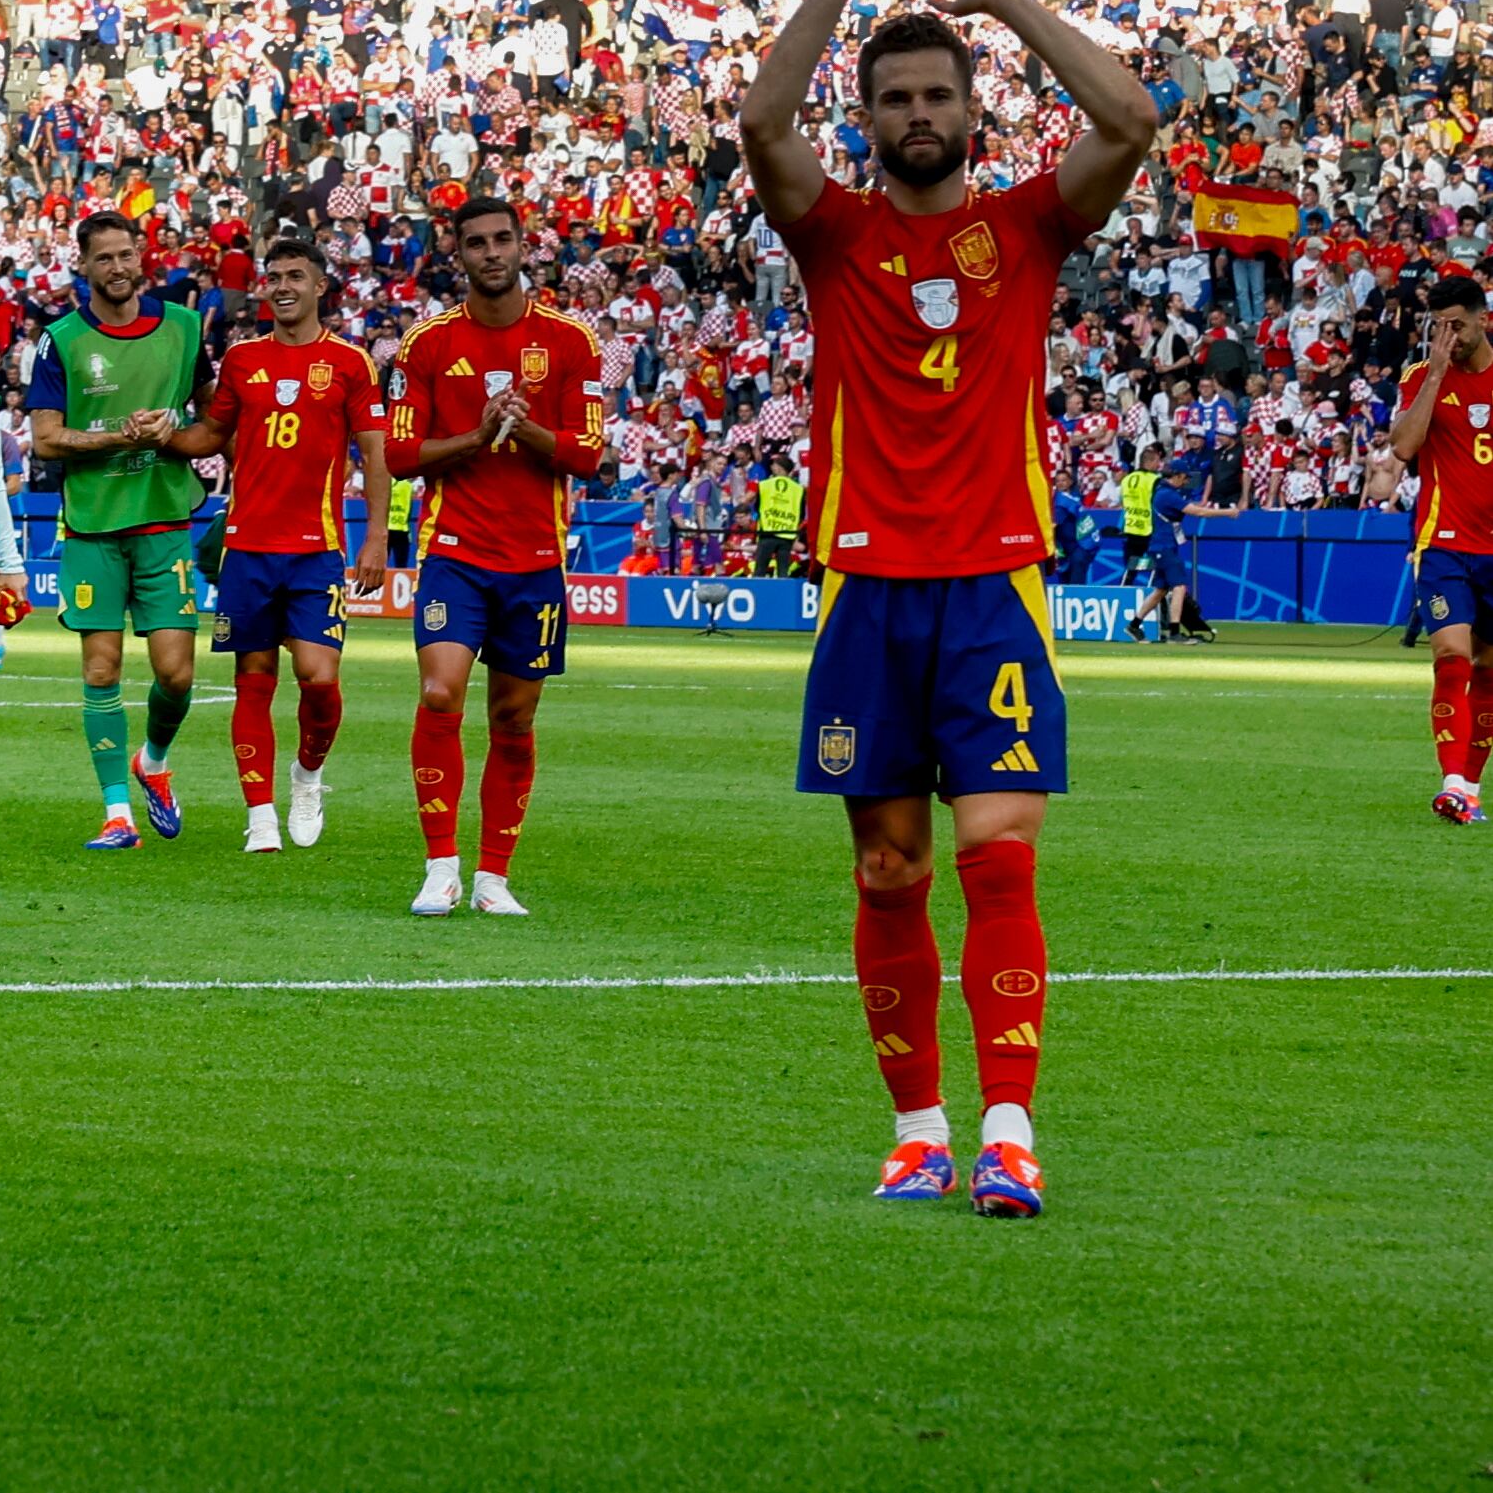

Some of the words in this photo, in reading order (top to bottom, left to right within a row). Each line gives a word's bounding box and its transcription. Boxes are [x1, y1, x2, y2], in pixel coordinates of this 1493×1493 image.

[919, 334, 961, 392] 4
[265, 411, 301, 449] 18
[1473, 433, 1493, 465] 6
[327, 584, 348, 621] 18
[537, 603, 560, 646] 11
[988, 662, 1033, 733] 4
